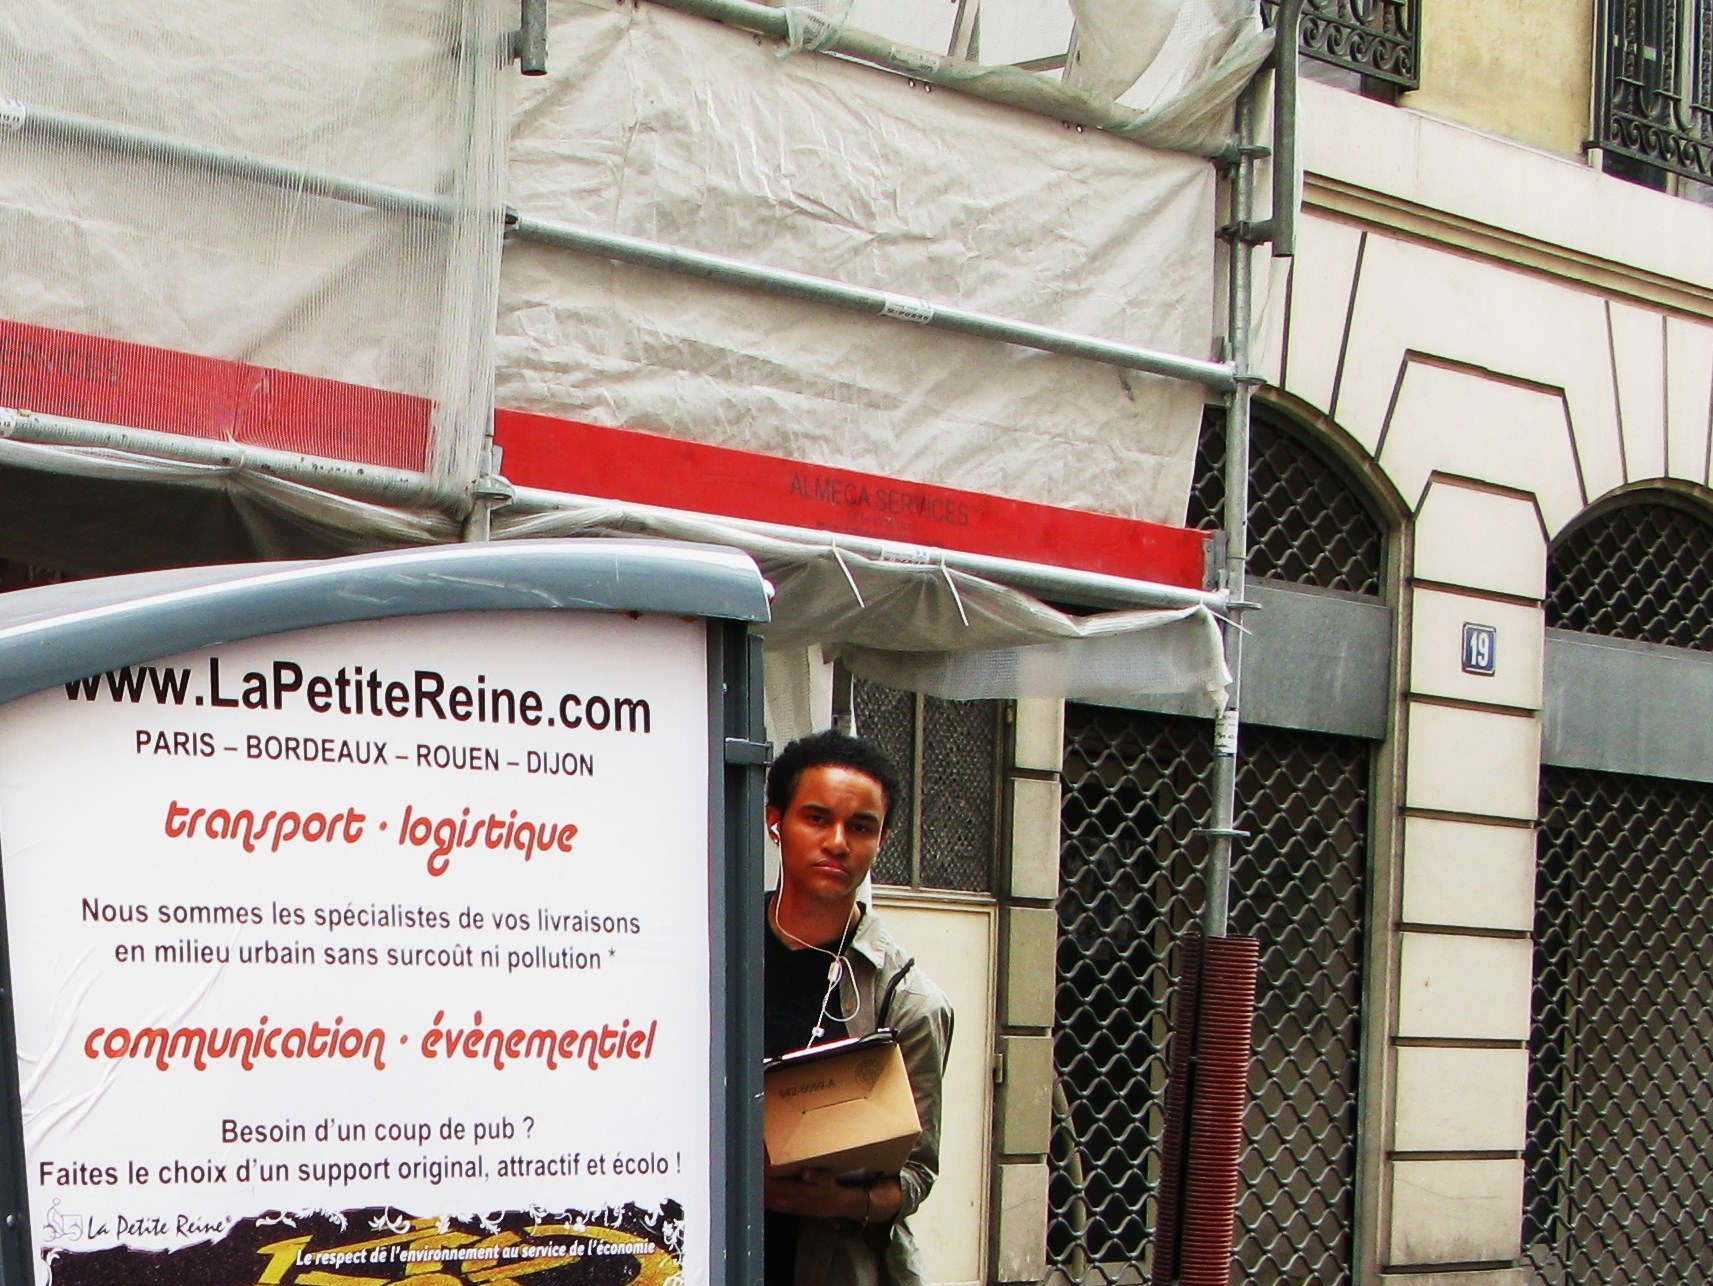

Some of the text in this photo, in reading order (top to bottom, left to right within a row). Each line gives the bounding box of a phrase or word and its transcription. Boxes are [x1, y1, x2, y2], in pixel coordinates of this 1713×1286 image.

[790, 471, 969, 527] ALMECA SERVICES
[1470, 630, 1489, 667] 19
[64, 657, 651, 734] www.LaPetiteReine.com
[136, 729, 216, 758] PARIS
[246, 734, 388, 765] BORDEAUX
[416, 743, 499, 771] ROUEN
[527, 750, 594, 777] DIJON
[165, 801, 366, 853] transport
[399, 805, 578, 877] logistique
[82, 897, 641, 934] Nous sommes les spécialistes de vos livraisons
[114, 944, 145, 963] en
[155, 939, 230, 964] milieu
[239, 940, 315, 964] urbain
[324, 947, 379, 966] sans
[388, 941, 473, 967] surcoût
[481, 942, 500, 967] ni
[508, 946, 601, 973] pollution
[84, 1016, 385, 1072] communication
[222, 1116, 535, 1147] Besoin d'un coup de pub ?
[39, 1152, 682, 1187] Faites le choix d'un support original, attractif et écolo !
[87, 1215, 110, 1240] La
[117, 1214, 170, 1241] Petite
[296, 1237, 656, 1269] Le respect de l'environnement au service de l'économie
